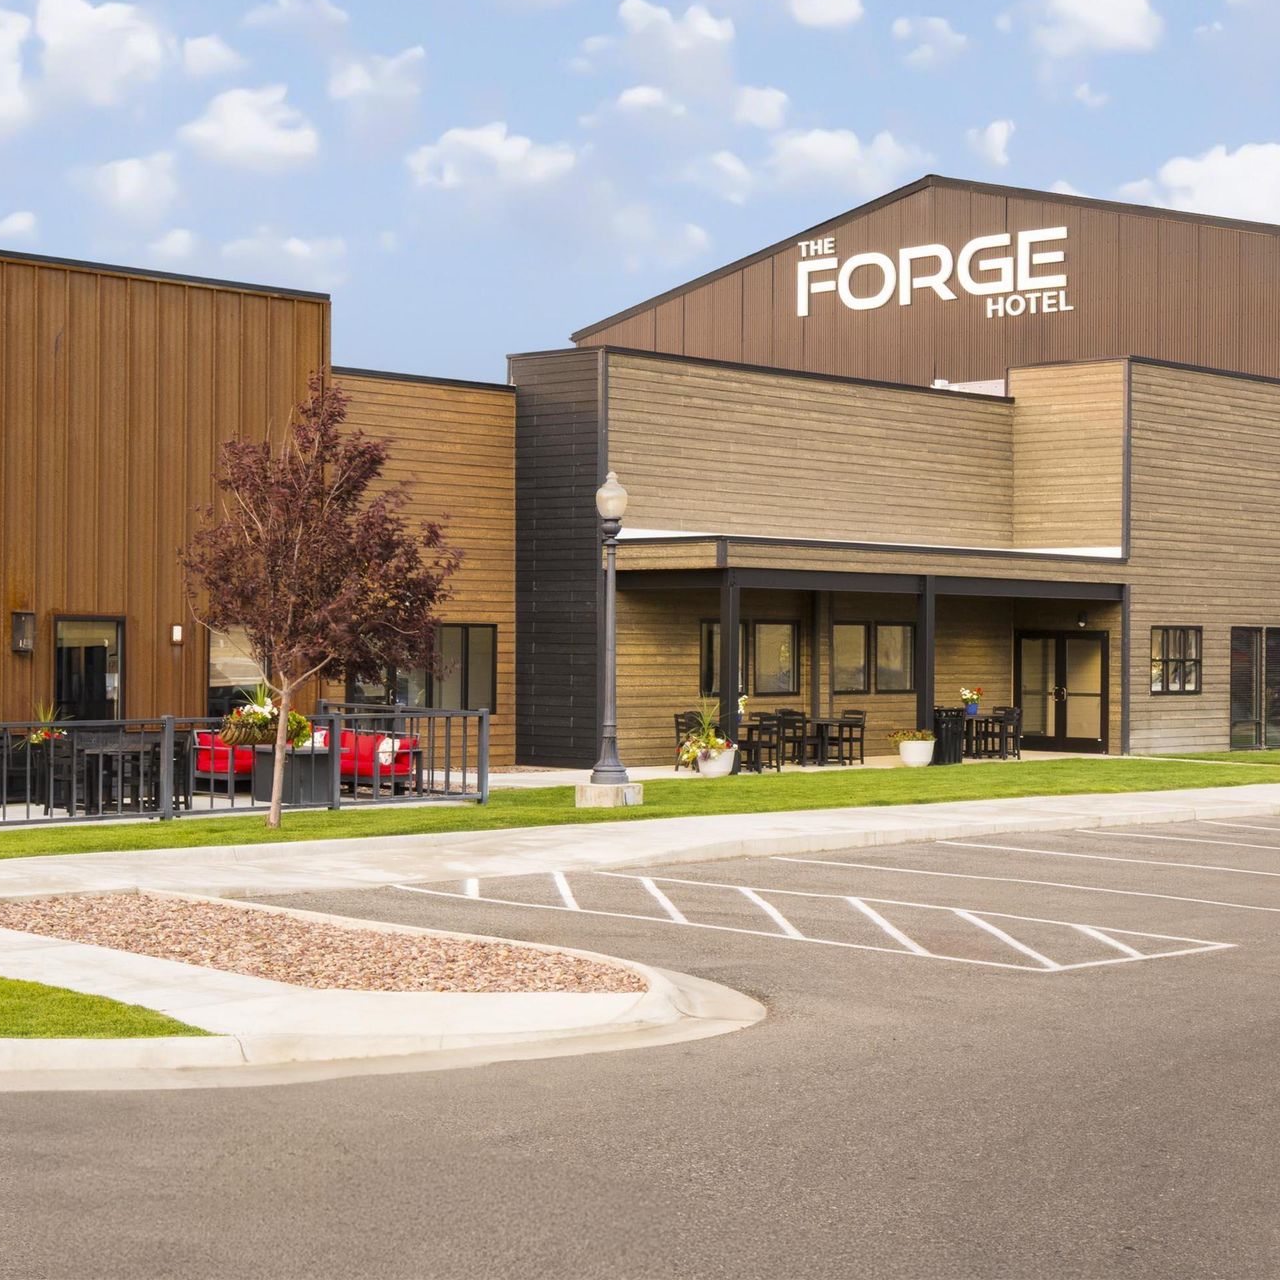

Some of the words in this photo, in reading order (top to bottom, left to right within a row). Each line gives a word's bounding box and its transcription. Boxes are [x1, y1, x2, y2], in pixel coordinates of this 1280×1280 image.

[797, 237, 835, 257] THE
[797, 226, 1068, 317] FORGE
[986, 290, 1074, 318] HOTEL
